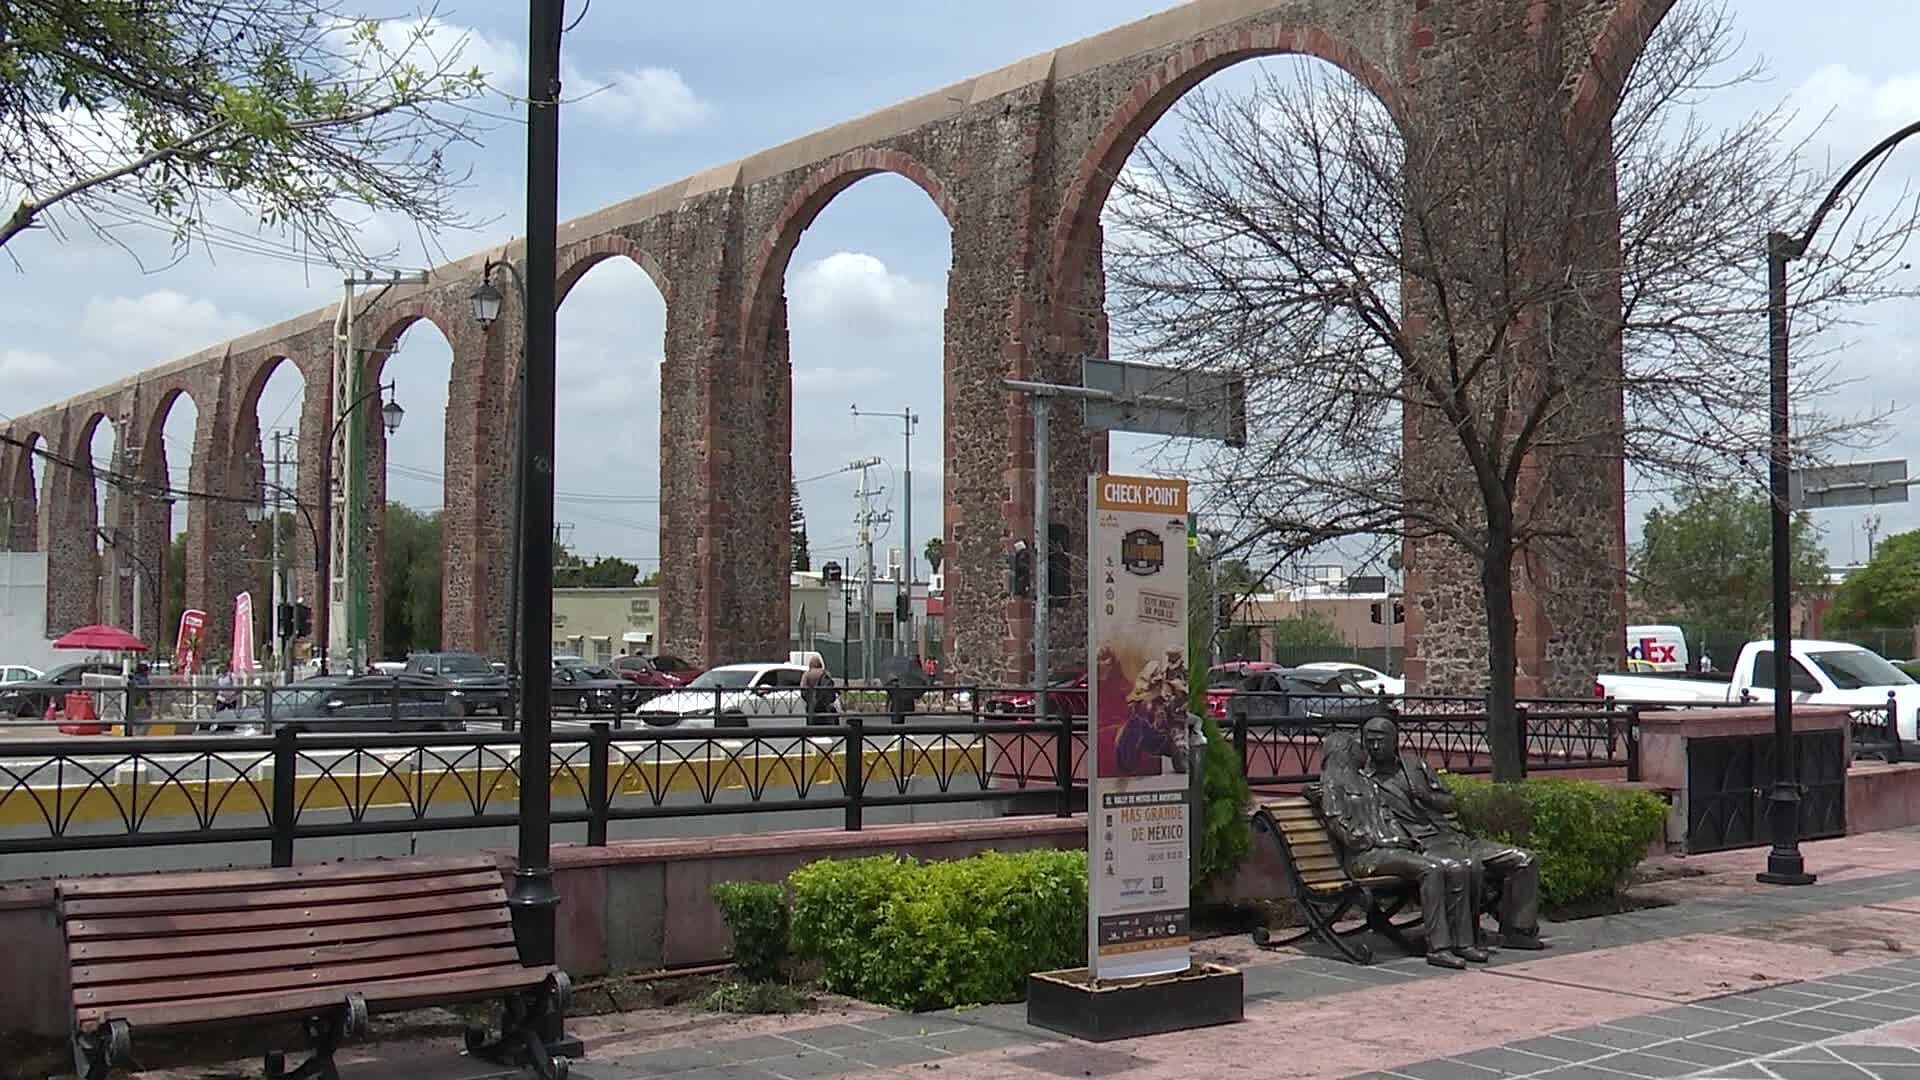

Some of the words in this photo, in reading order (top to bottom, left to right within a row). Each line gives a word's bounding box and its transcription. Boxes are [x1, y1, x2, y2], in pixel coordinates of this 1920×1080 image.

[1104, 483, 1142, 504] CHECK
[1145, 486, 1180, 507] POINT
[1626, 637, 1676, 663] dEx
[1145, 806, 1184, 822] GRANDE
[1131, 826, 1144, 842] DE
